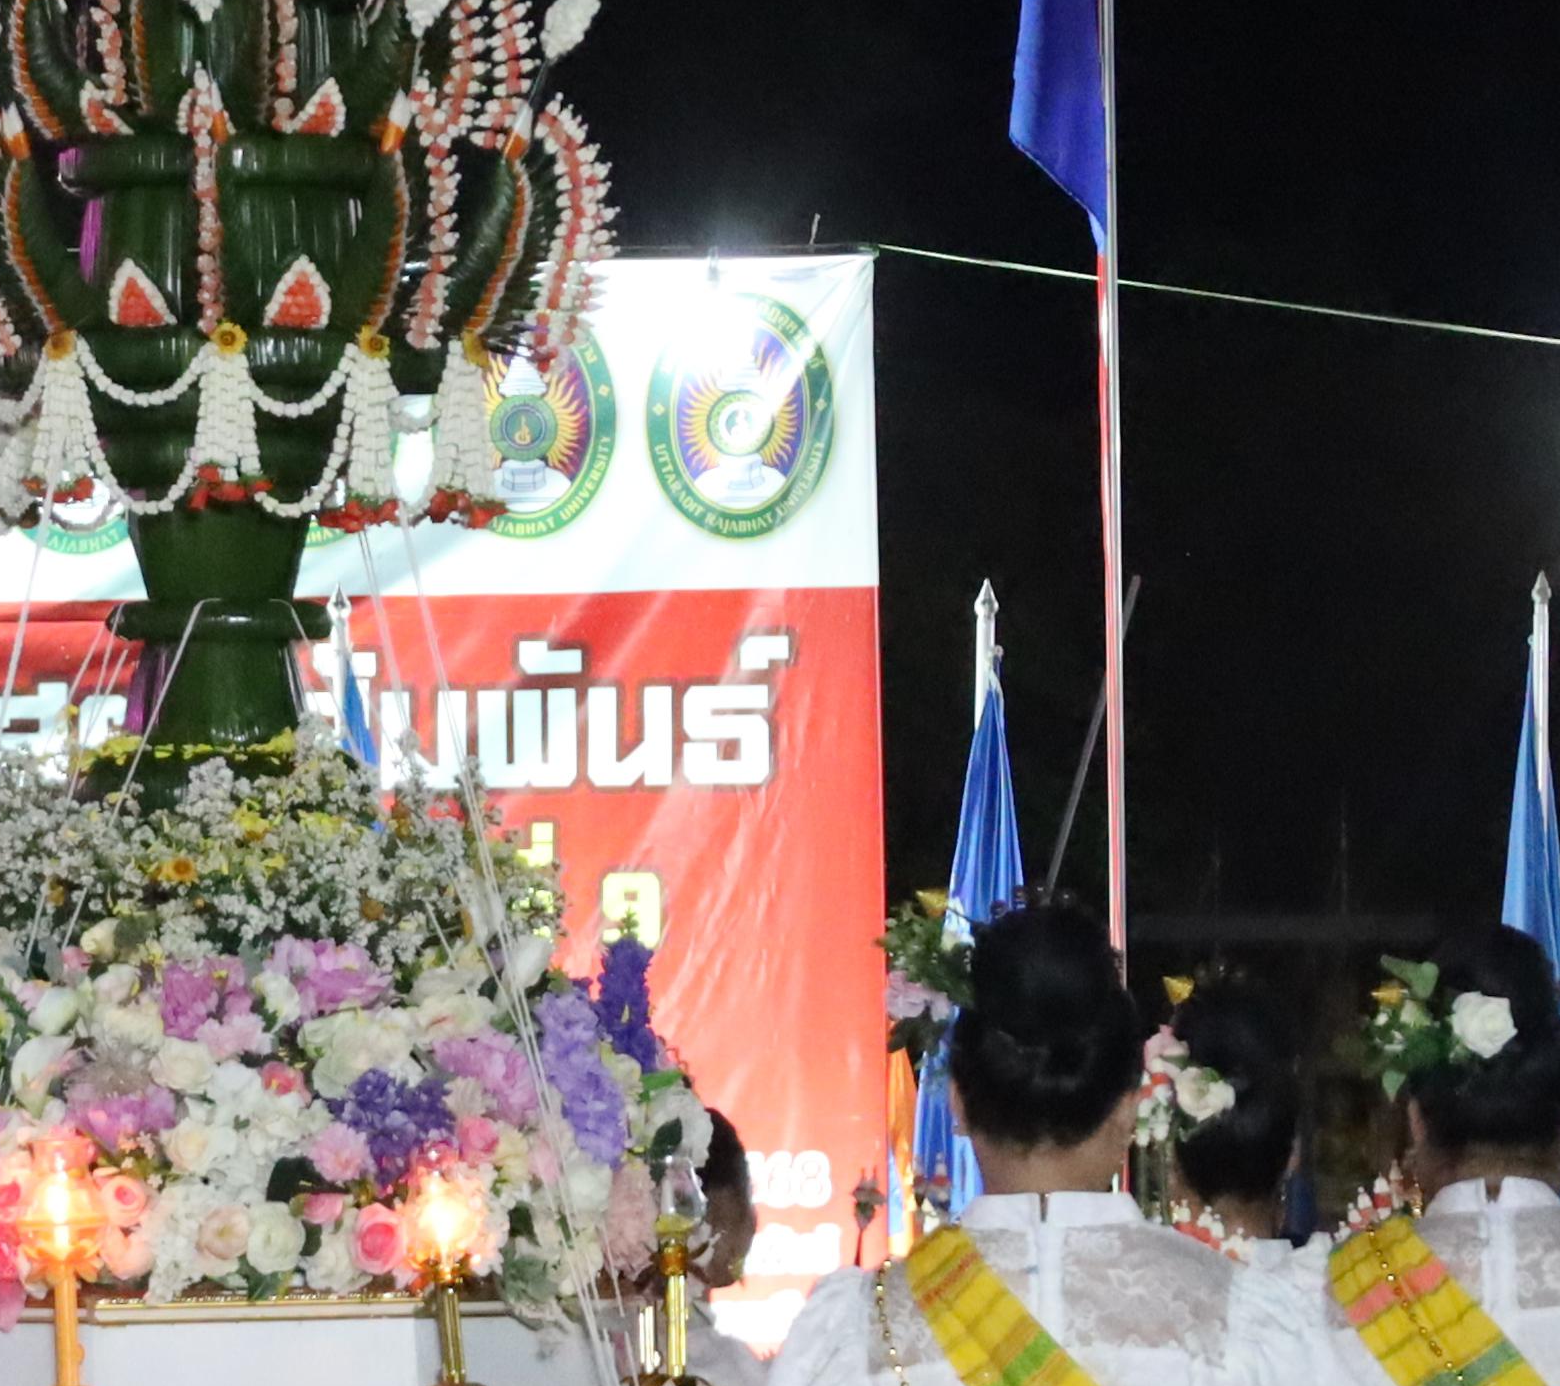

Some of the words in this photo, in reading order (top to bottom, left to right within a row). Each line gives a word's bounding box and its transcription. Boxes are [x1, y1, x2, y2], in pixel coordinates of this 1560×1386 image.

[558, 435, 613, 522] UNIVERSITY
[653, 442, 704, 518] UTTARADIT
[704, 509, 775, 536] RAJABHAT
[775, 441, 826, 518] UNIVERSITY
